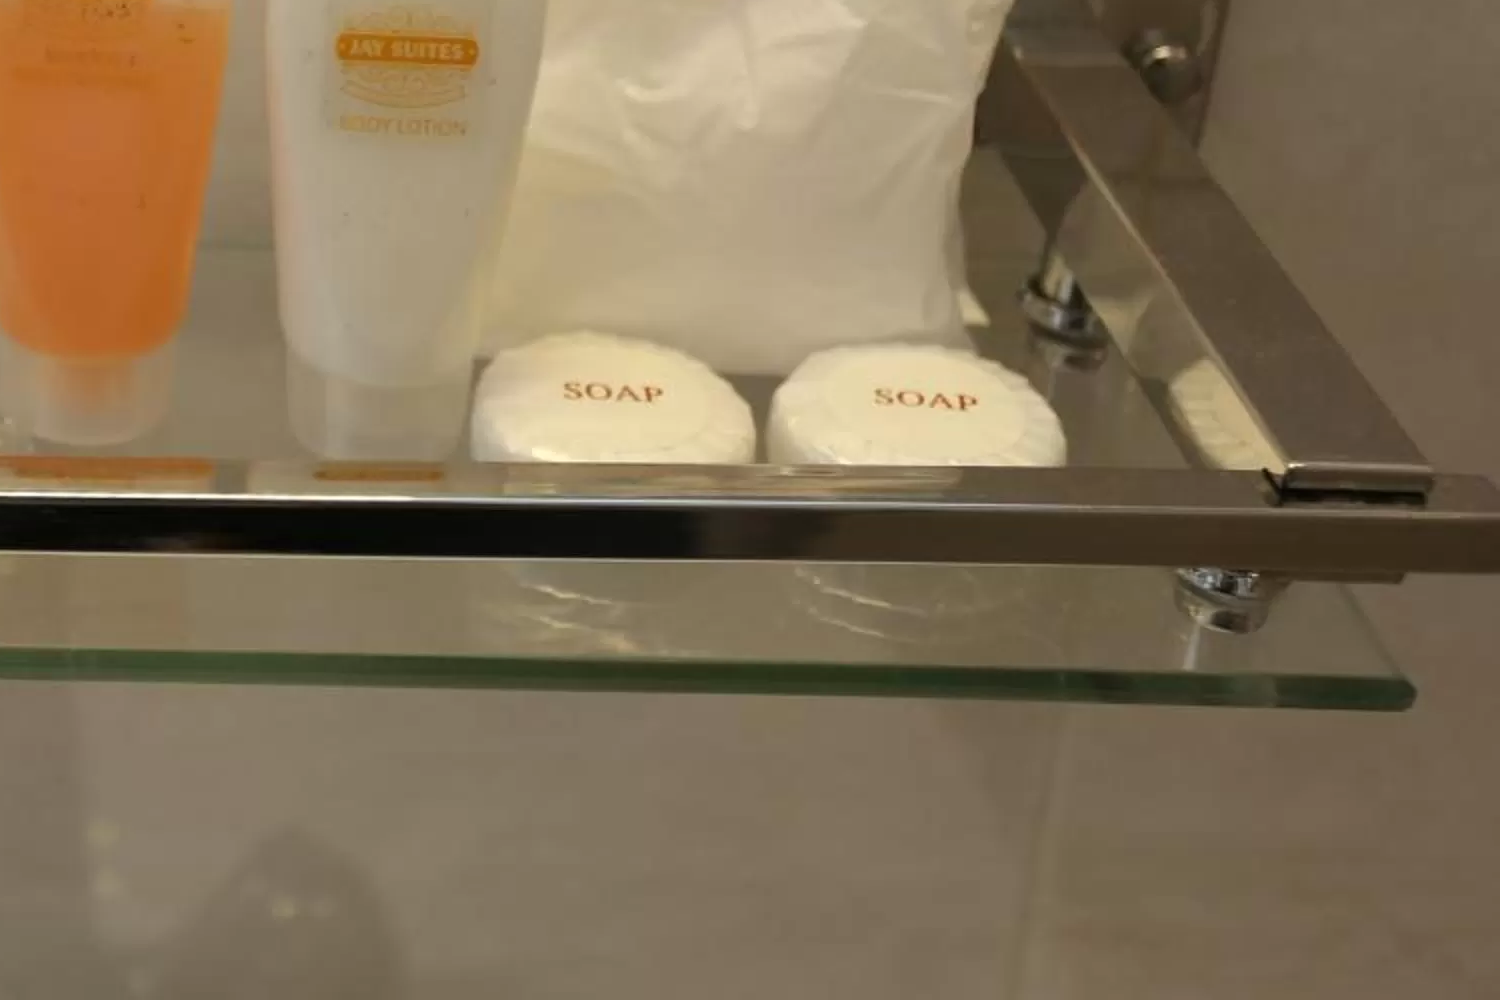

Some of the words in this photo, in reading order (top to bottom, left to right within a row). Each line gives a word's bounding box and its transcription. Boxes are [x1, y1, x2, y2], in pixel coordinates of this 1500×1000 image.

[350, 38, 383, 58] JAY
[391, 40, 465, 61] SUITES
[397, 118, 470, 138] LOTION
[563, 380, 664, 405] SOAP
[873, 387, 979, 412] SOAP
